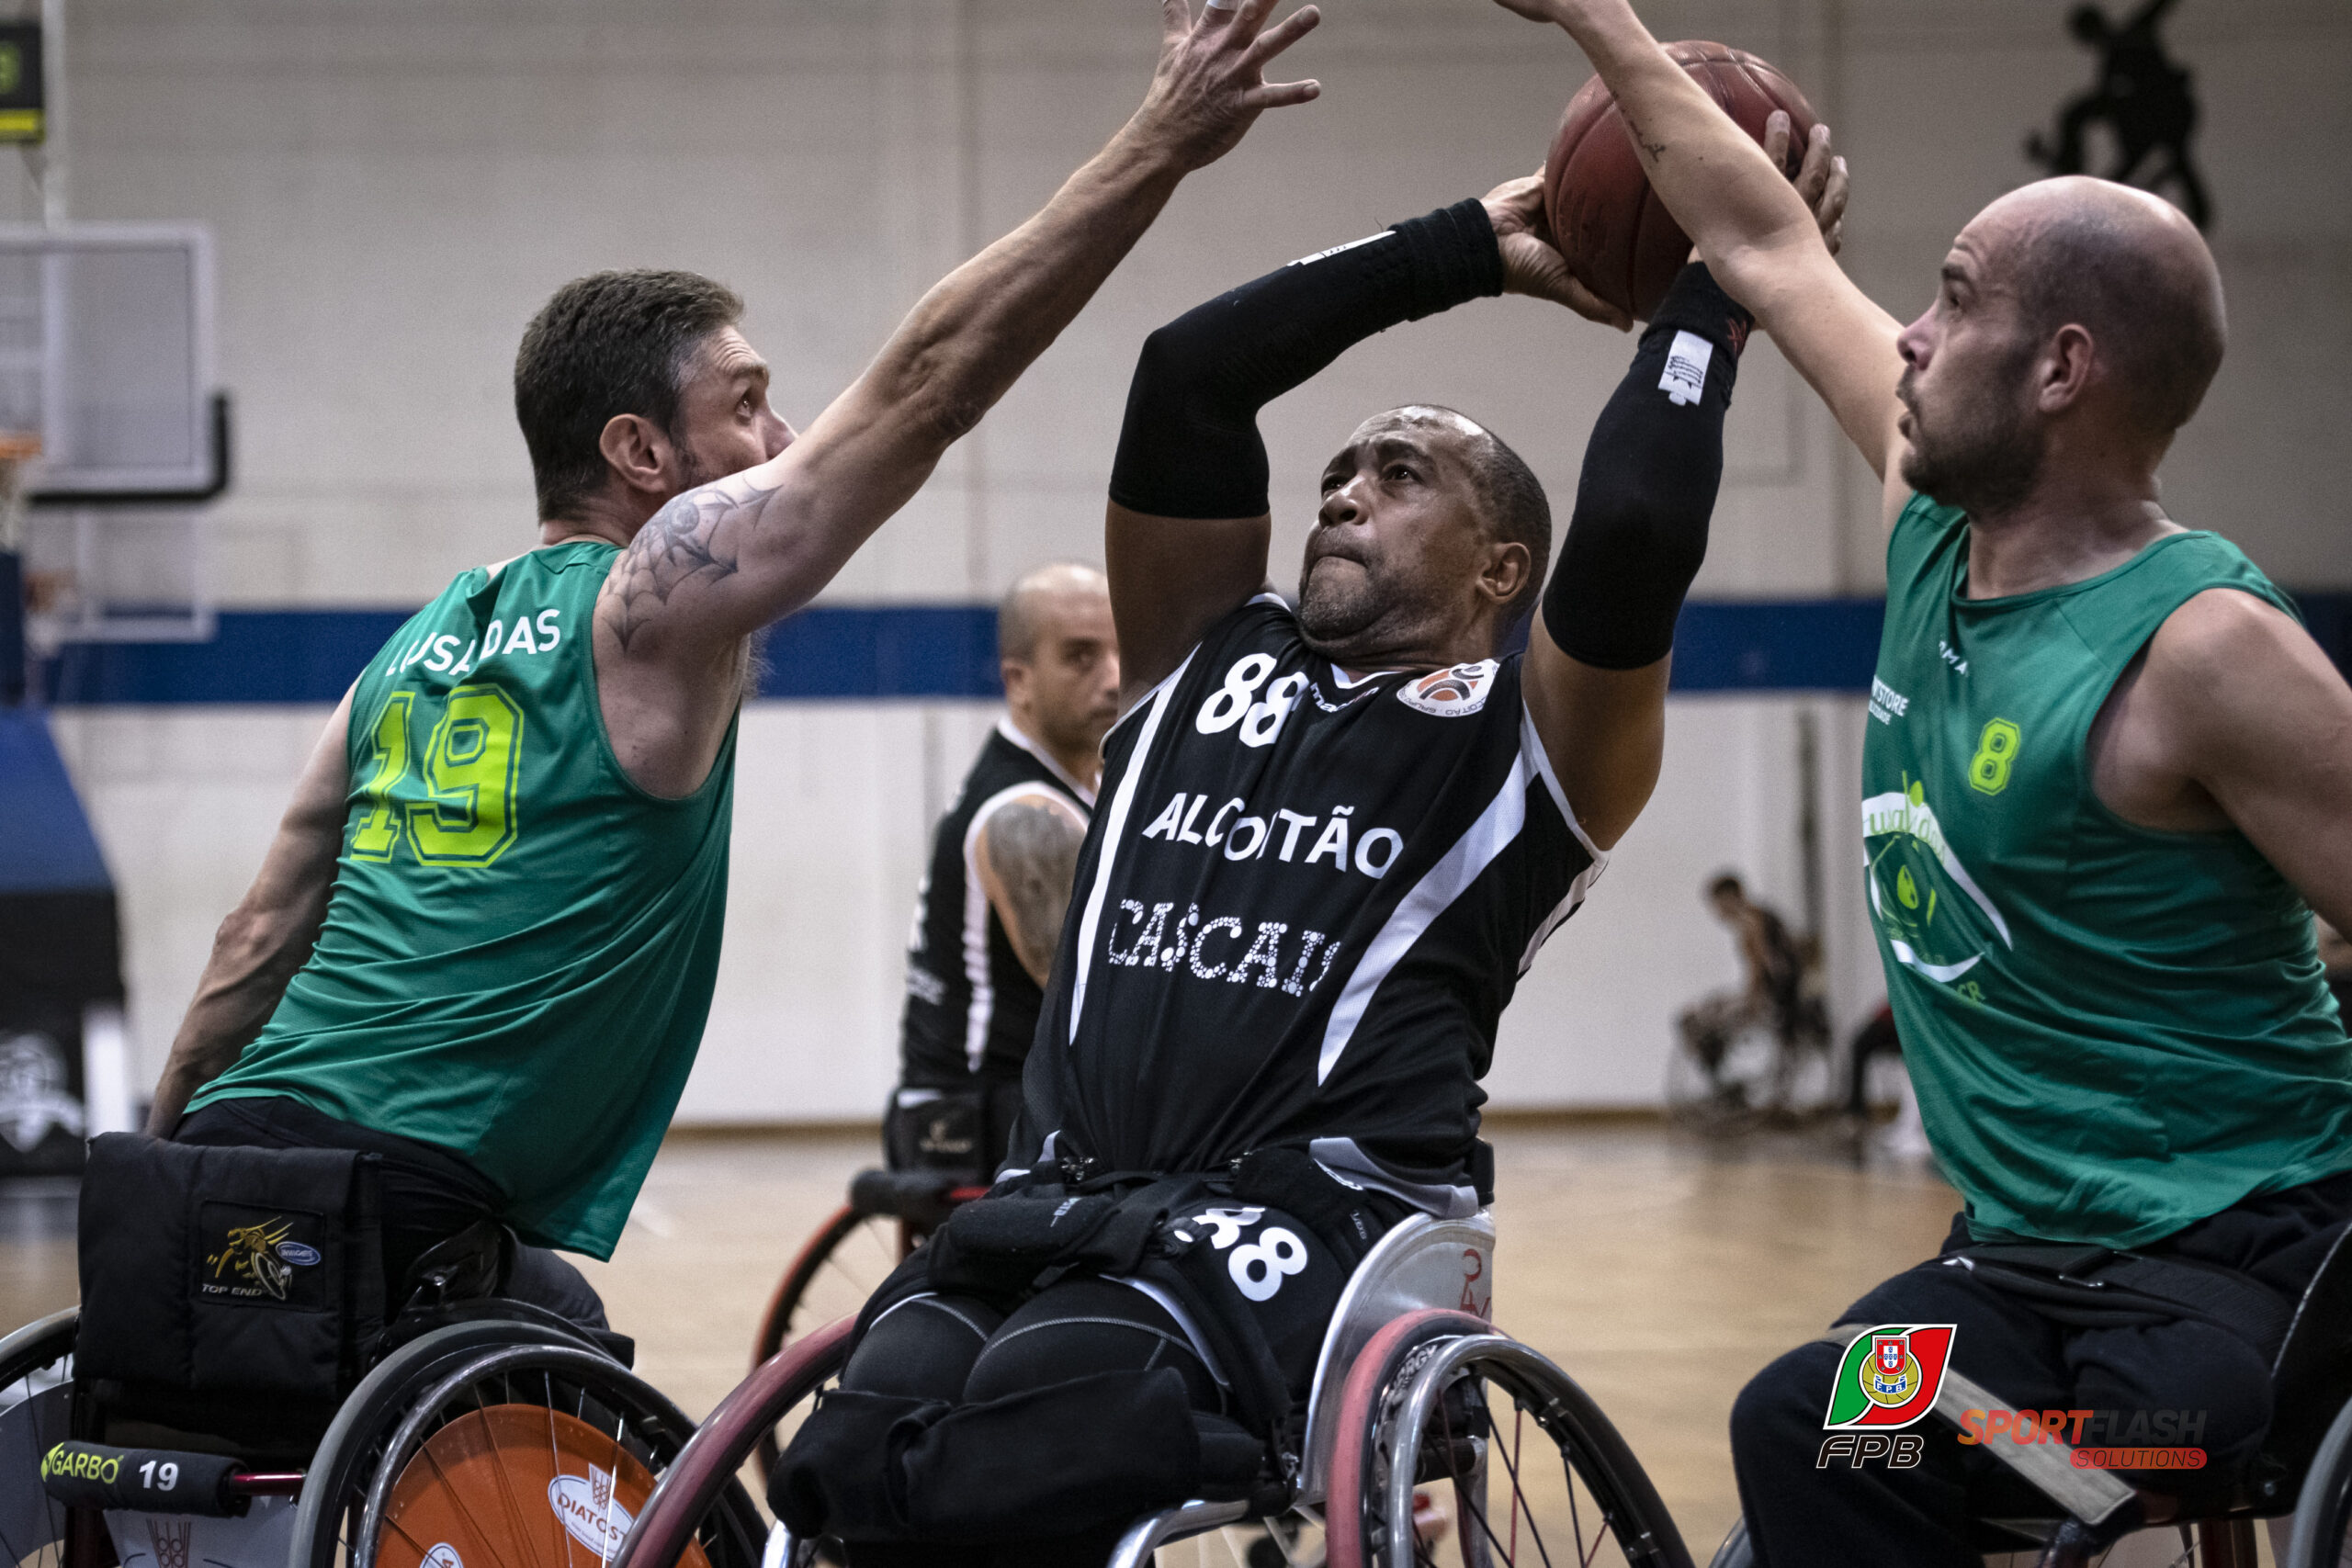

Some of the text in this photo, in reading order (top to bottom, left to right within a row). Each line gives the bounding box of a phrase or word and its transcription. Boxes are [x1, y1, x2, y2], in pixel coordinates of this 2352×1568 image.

[1195, 653, 1310, 748] 88
[350, 683, 525, 868] 19
[1968, 716, 2020, 796] 8
[202, 1283, 263, 1296] TOP END
[139, 1461, 179, 1492] 19
